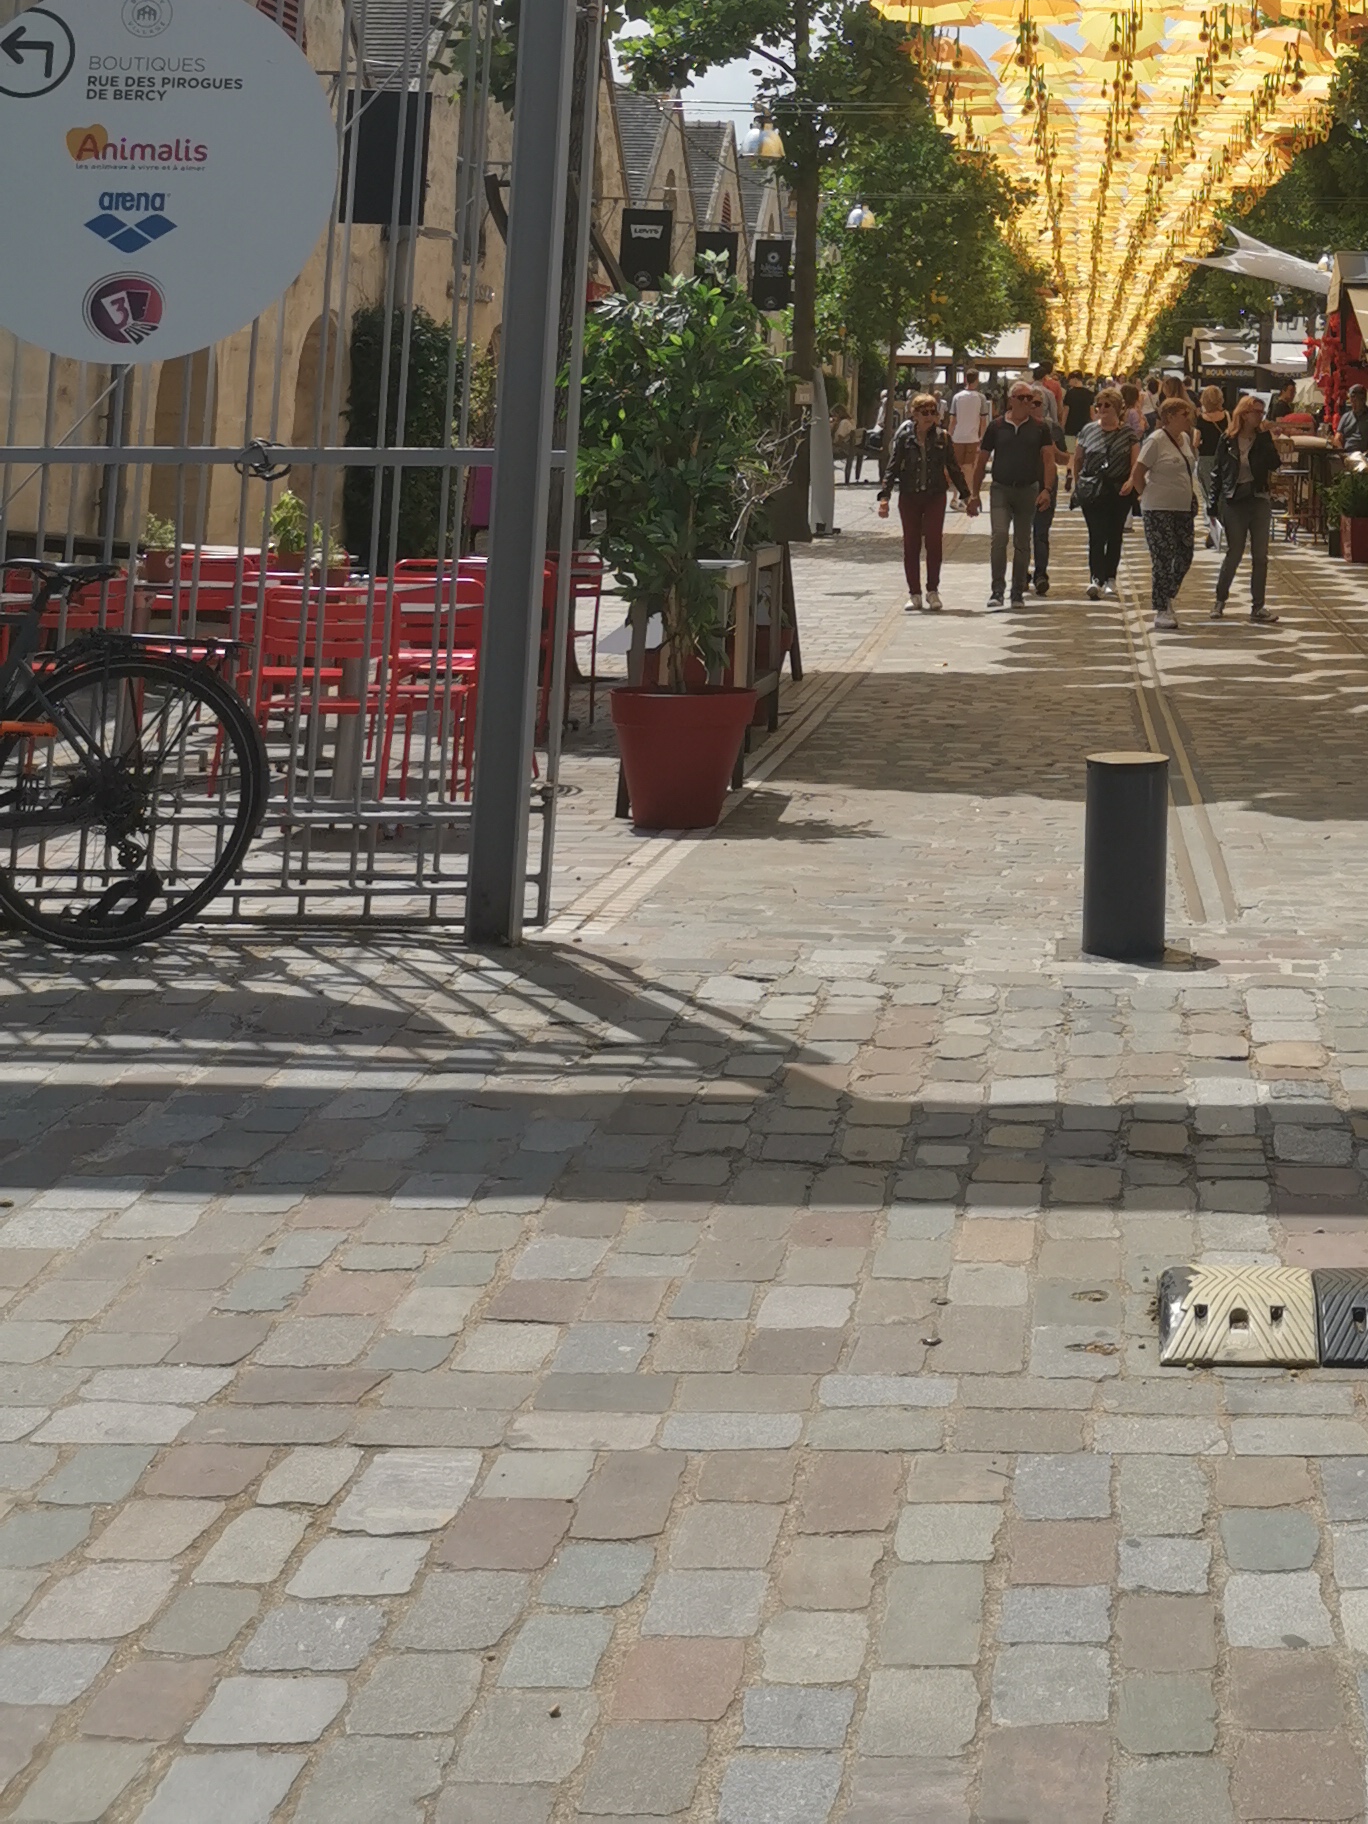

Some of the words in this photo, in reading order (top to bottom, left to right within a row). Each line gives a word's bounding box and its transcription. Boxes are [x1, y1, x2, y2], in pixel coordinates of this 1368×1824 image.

[88, 56, 206, 73] BOUTIQUES
[87, 76, 119, 87] RUE
[124, 76, 156, 88] DES
[161, 77, 243, 90] PIROGUES
[86, 89, 108, 100] DE
[112, 89, 168, 102] BERCY
[76, 133, 208, 162] Animalis
[99, 191, 166, 212] arena
